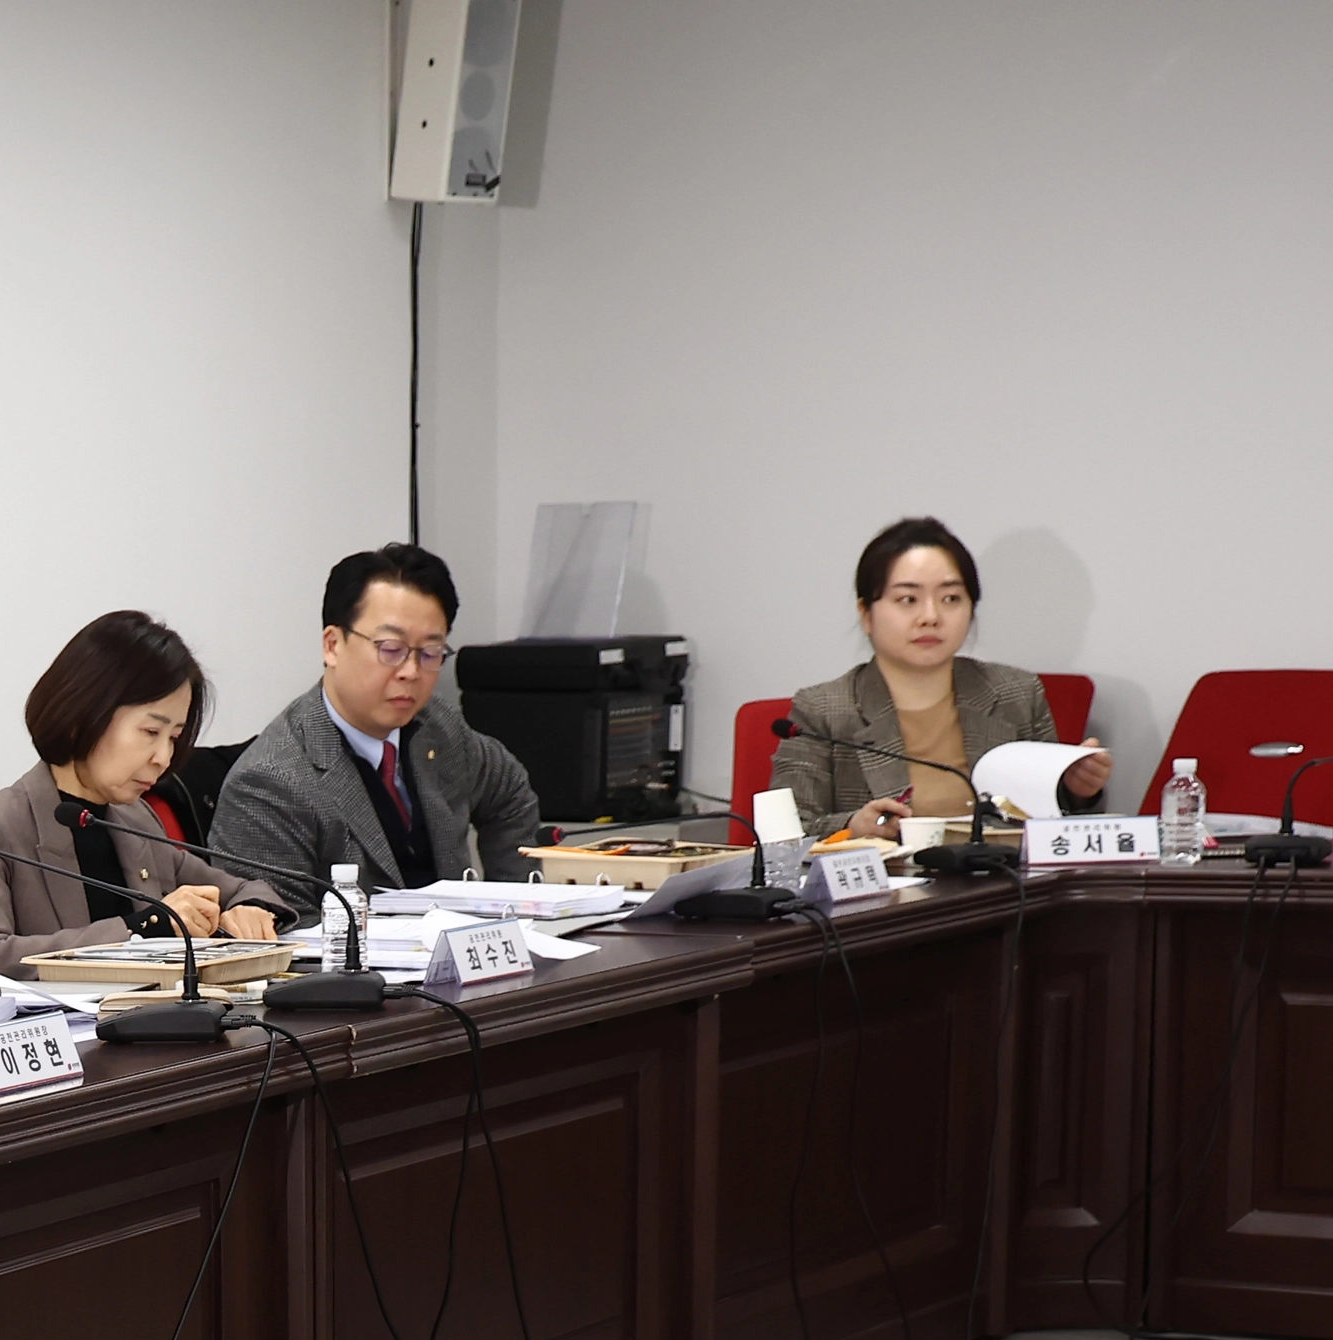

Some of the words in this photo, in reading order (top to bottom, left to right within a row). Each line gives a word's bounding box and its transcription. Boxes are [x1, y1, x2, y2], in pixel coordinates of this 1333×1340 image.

[466, 939, 518, 971] 최수진
[0, 1025, 49, 1044] 공천관리위원장
[0, 1037, 64, 1075] 이정현
